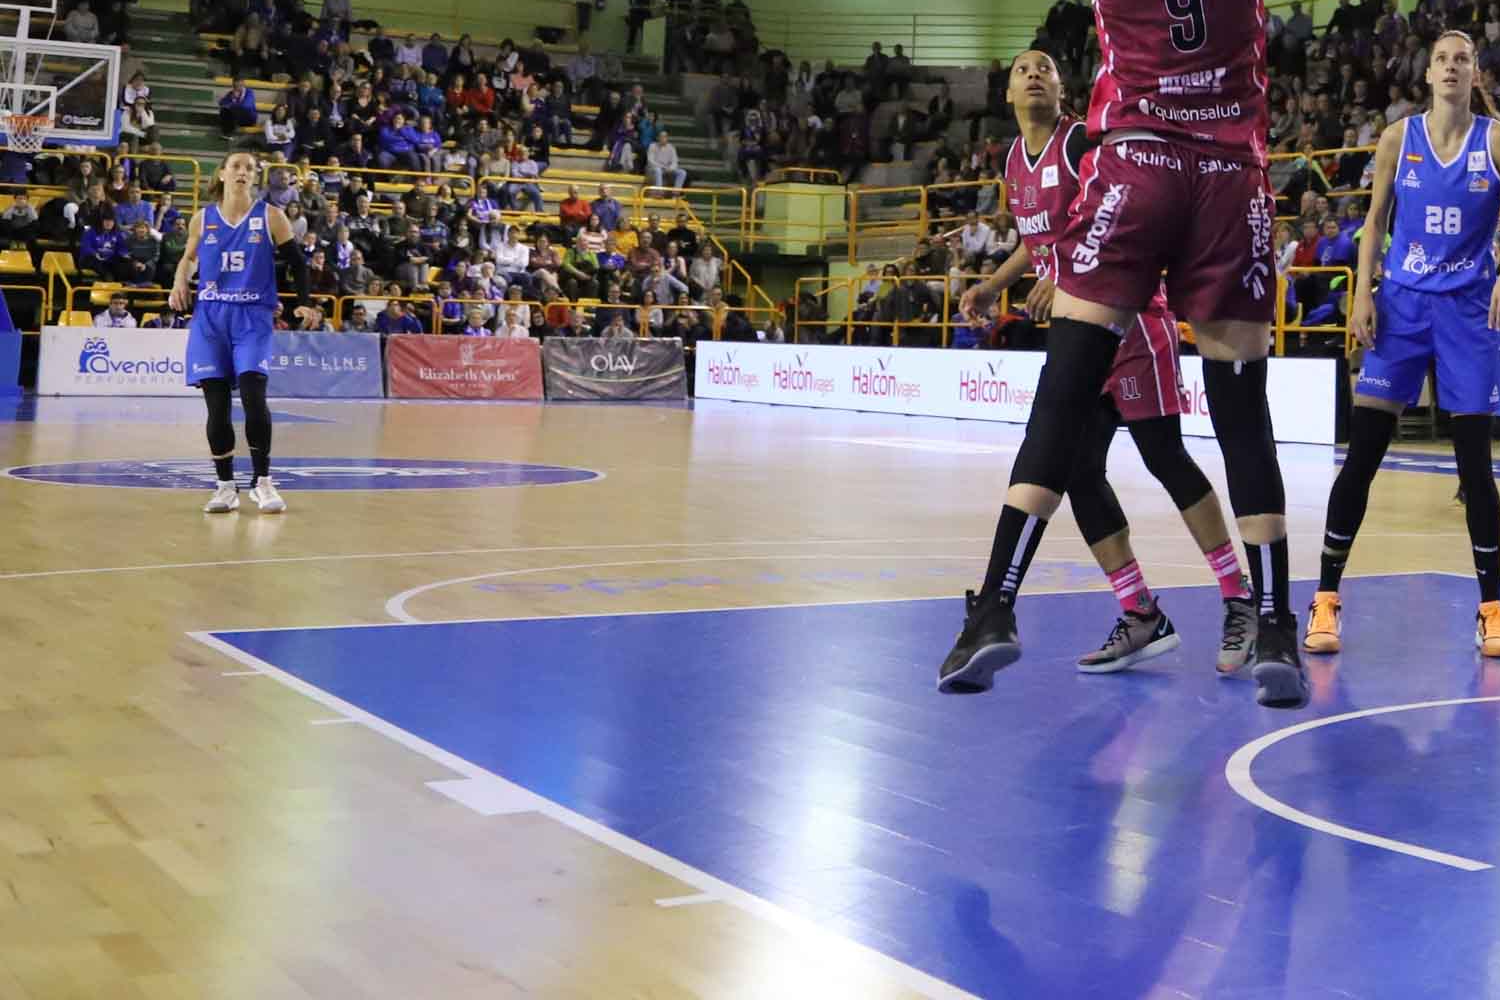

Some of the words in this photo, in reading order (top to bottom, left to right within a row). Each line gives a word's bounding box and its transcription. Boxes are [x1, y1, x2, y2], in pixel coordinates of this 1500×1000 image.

[1425, 205, 1462, 235] 28
[220, 251, 246, 273] 15
[90, 353, 185, 374] avenida
[419, 367, 477, 381] Elizabeth
[478, 368, 515, 382] Arden
[1119, 376, 1142, 401] 11
